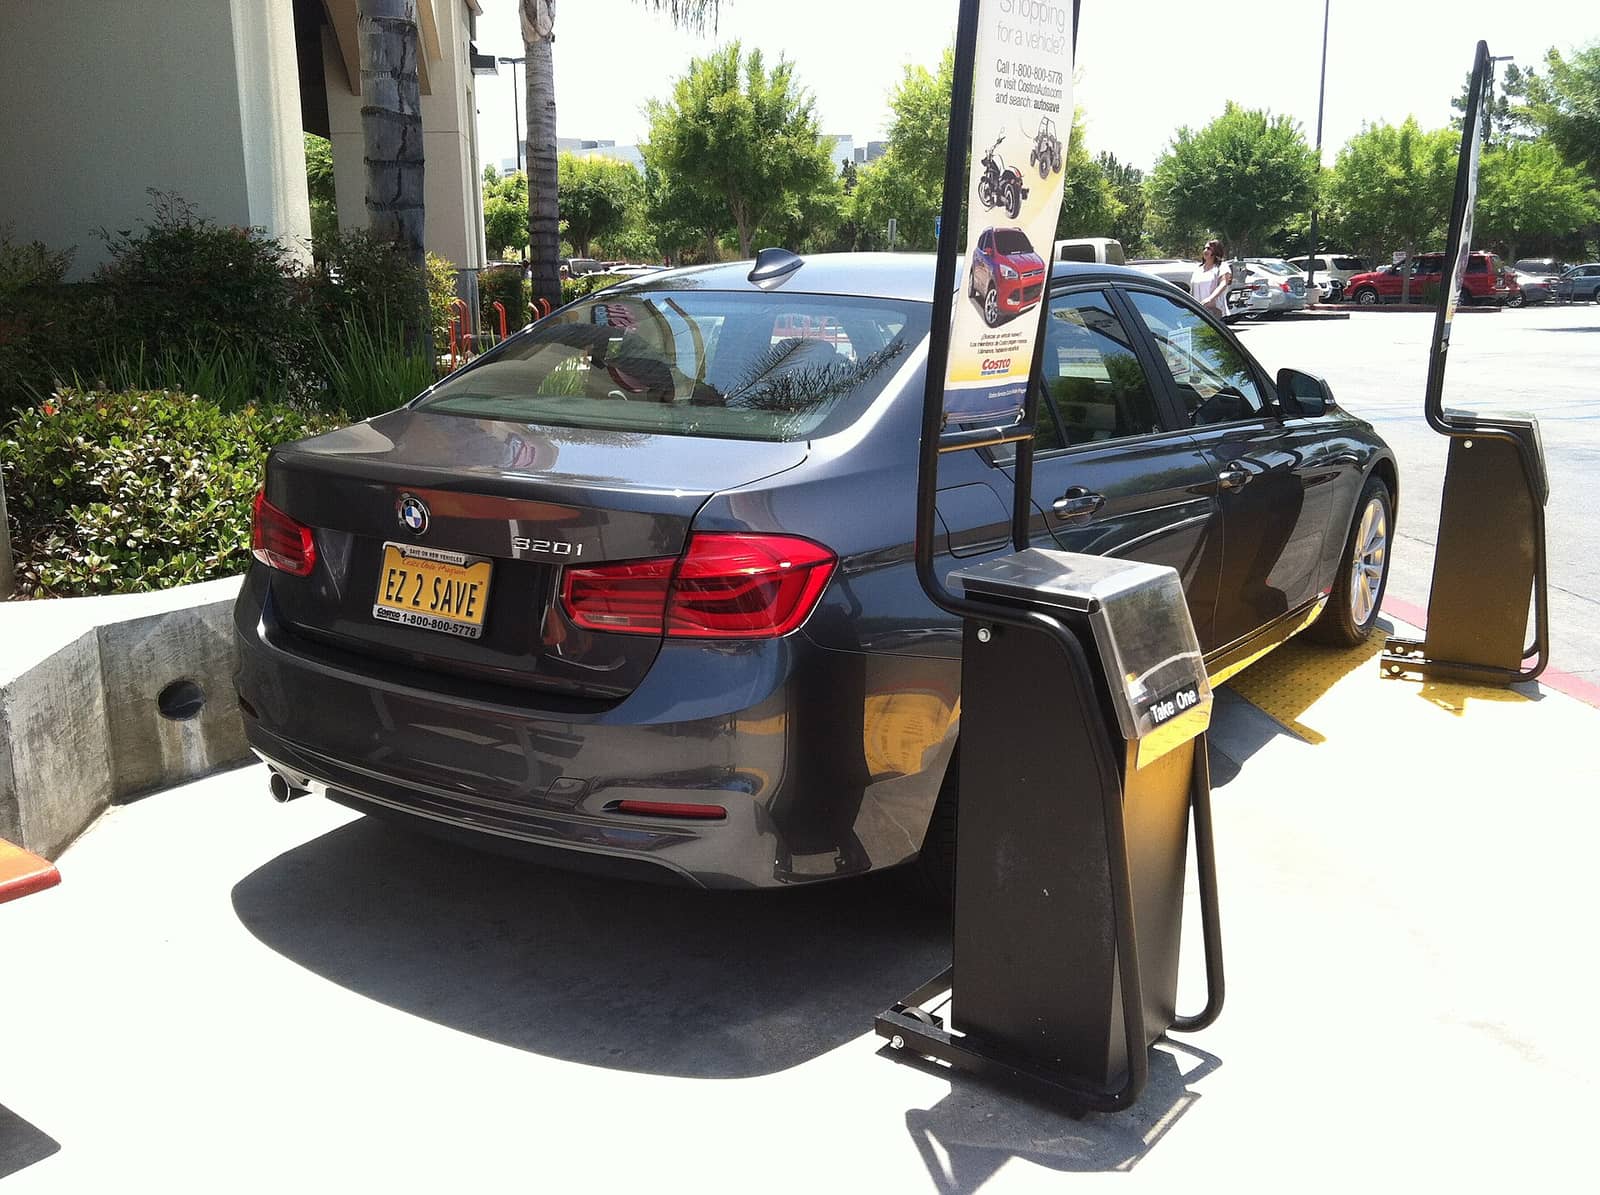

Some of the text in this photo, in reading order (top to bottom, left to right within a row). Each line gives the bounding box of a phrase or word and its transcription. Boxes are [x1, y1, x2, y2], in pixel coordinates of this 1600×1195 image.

[997, 20, 1066, 56] for a vehicle?
[994, 77, 1002, 88] or
[1003, 76, 1017, 91] visit
[996, 58, 1063, 86] Call 1-800-800-5778
[995, 92, 1008, 105] and
[1033, 98, 1060, 113] autosave
[409, 548, 421, 556] SAVE
[385, 568, 478, 617] EZ 2 SAVE
[401, 614, 477, 637] 1-800-800-5778
[1150, 689, 1196, 723] Take One
